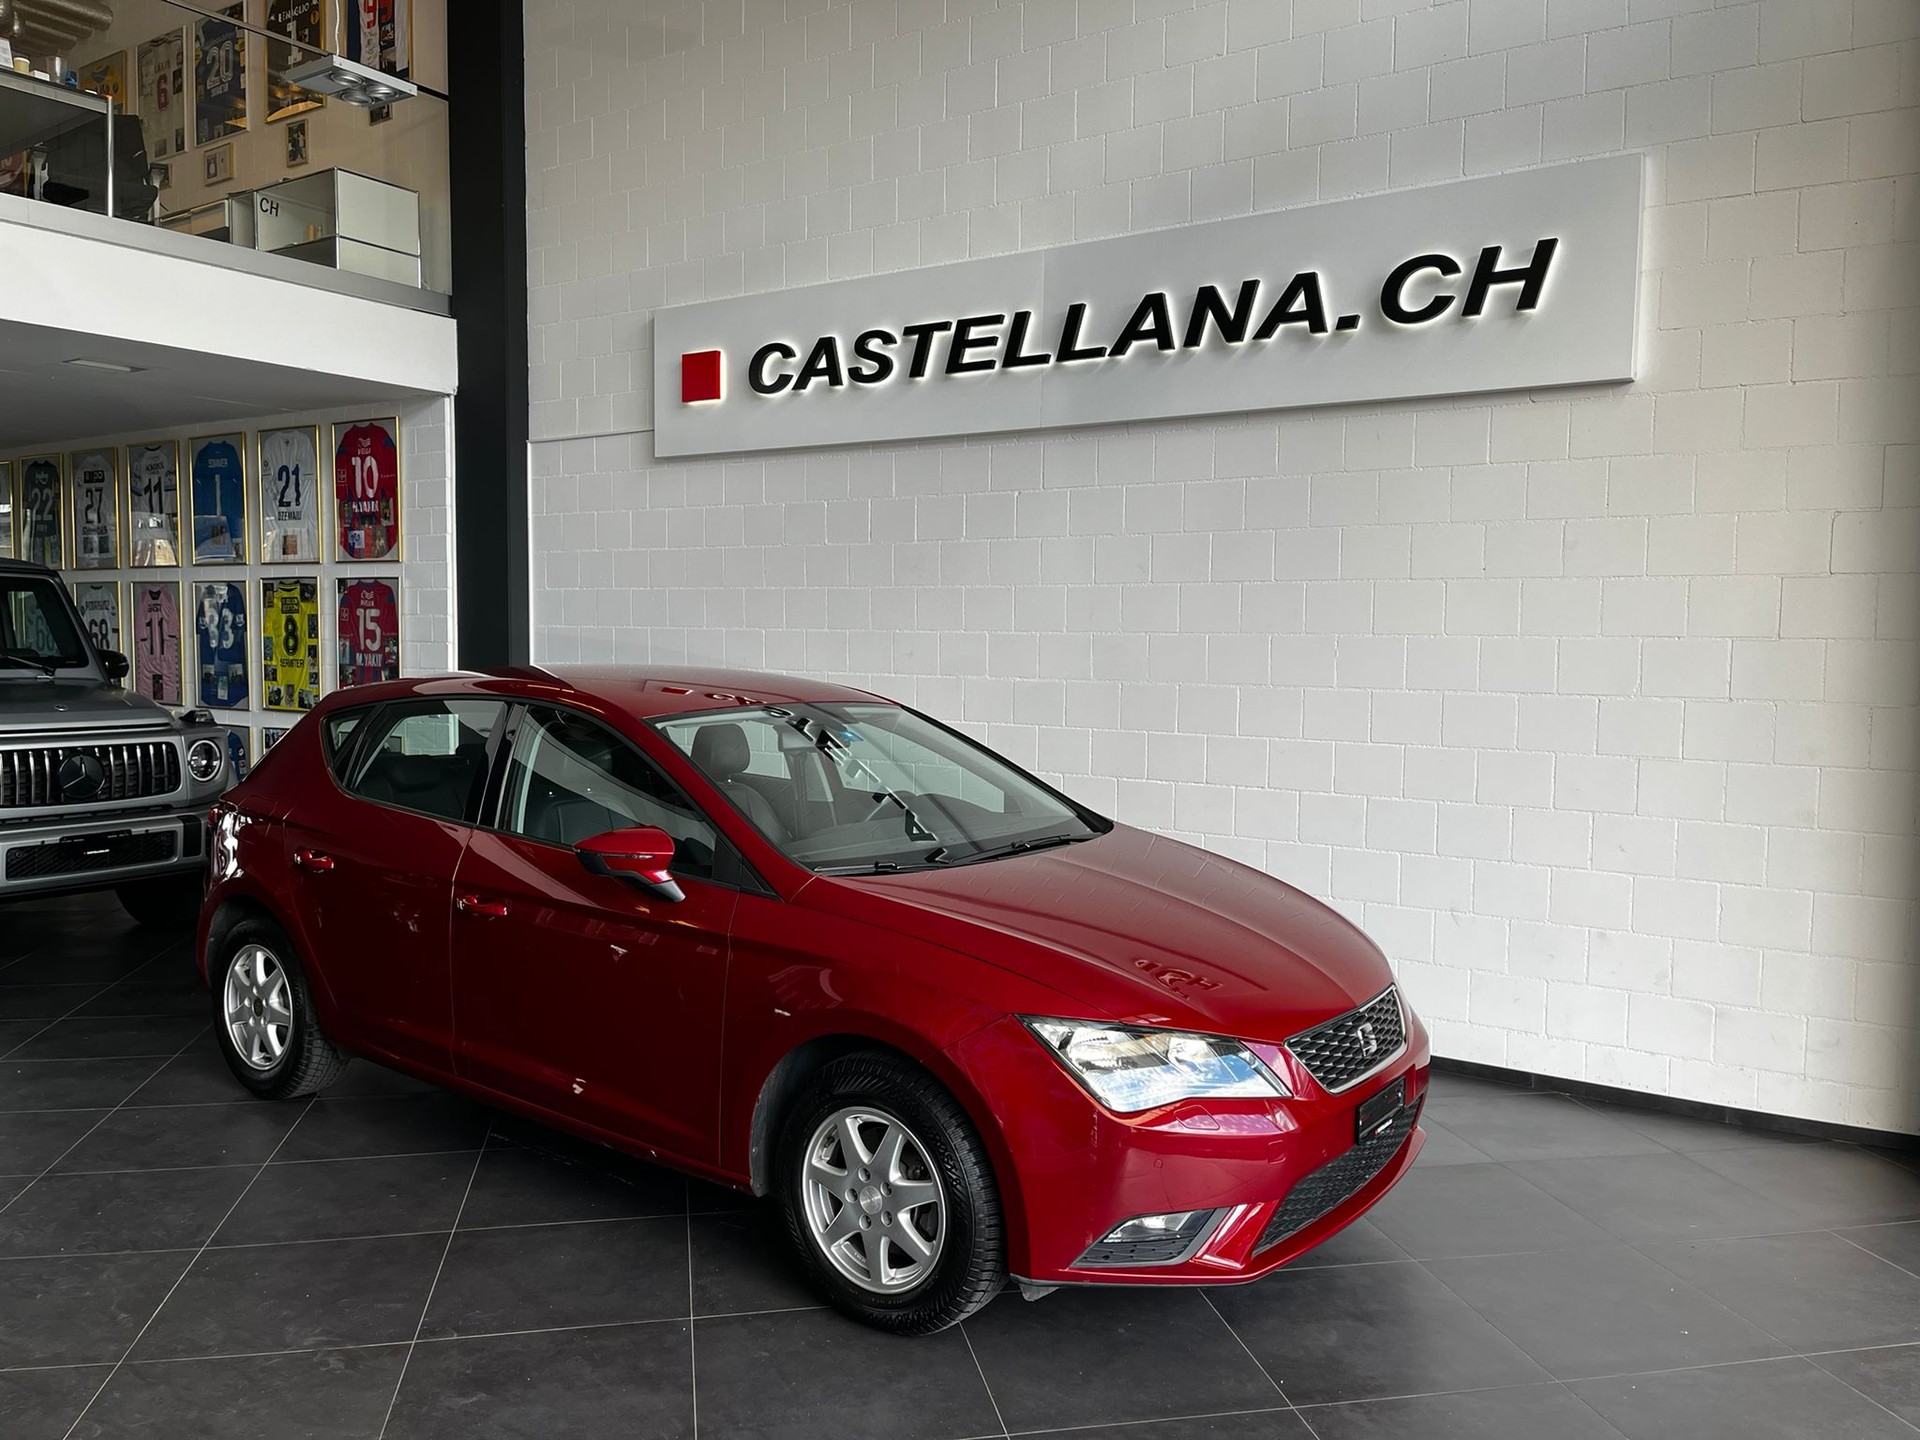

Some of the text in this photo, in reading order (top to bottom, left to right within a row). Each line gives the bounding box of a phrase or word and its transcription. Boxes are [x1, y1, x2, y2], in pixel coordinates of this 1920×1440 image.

[207, 40, 233, 90] 20
[260, 197, 279, 217] CH
[748, 237, 1558, 395] CASTELLANA.CH
[144, 476, 163, 515] 11
[215, 473, 222, 517] 1
[278, 463, 301, 508] 21
[352, 455, 379, 499] 10
[32, 487, 53, 521] 22
[85, 486, 104, 524] 27
[89, 618, 110, 650] 68
[145, 617, 165, 656] 11
[283, 614, 299, 656] 8
[356, 608, 382, 652] 15
